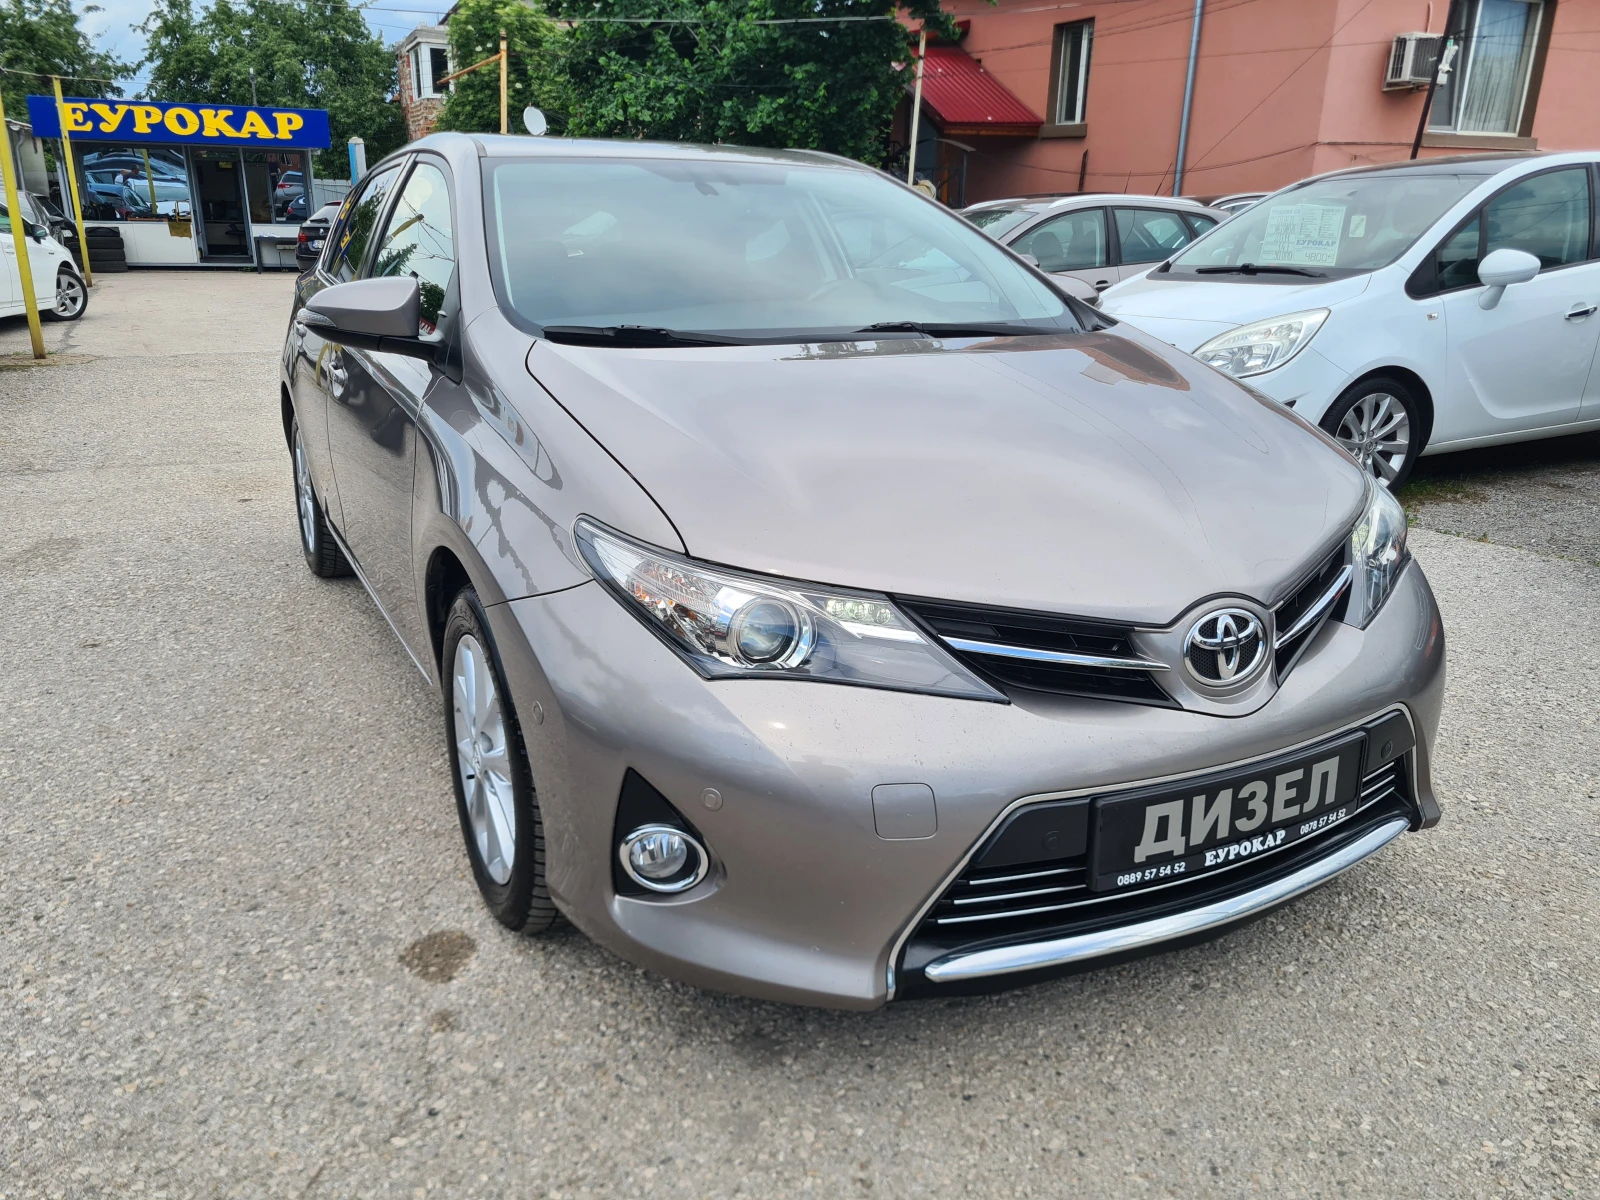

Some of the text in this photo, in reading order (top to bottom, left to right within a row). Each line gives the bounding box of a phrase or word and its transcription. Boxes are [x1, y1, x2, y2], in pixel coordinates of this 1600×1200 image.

[61, 102, 304, 140] ЕУРОКАР
[1296, 239, 1337, 247] ЕУРОКАР
[1134, 755, 1340, 864] ДИЗЕЛ
[1300, 808, 1346, 835] 0878 57 54 52
[1204, 829, 1286, 867] ЕУРОКАР
[1117, 862, 1186, 886] 0889 57 54 52
